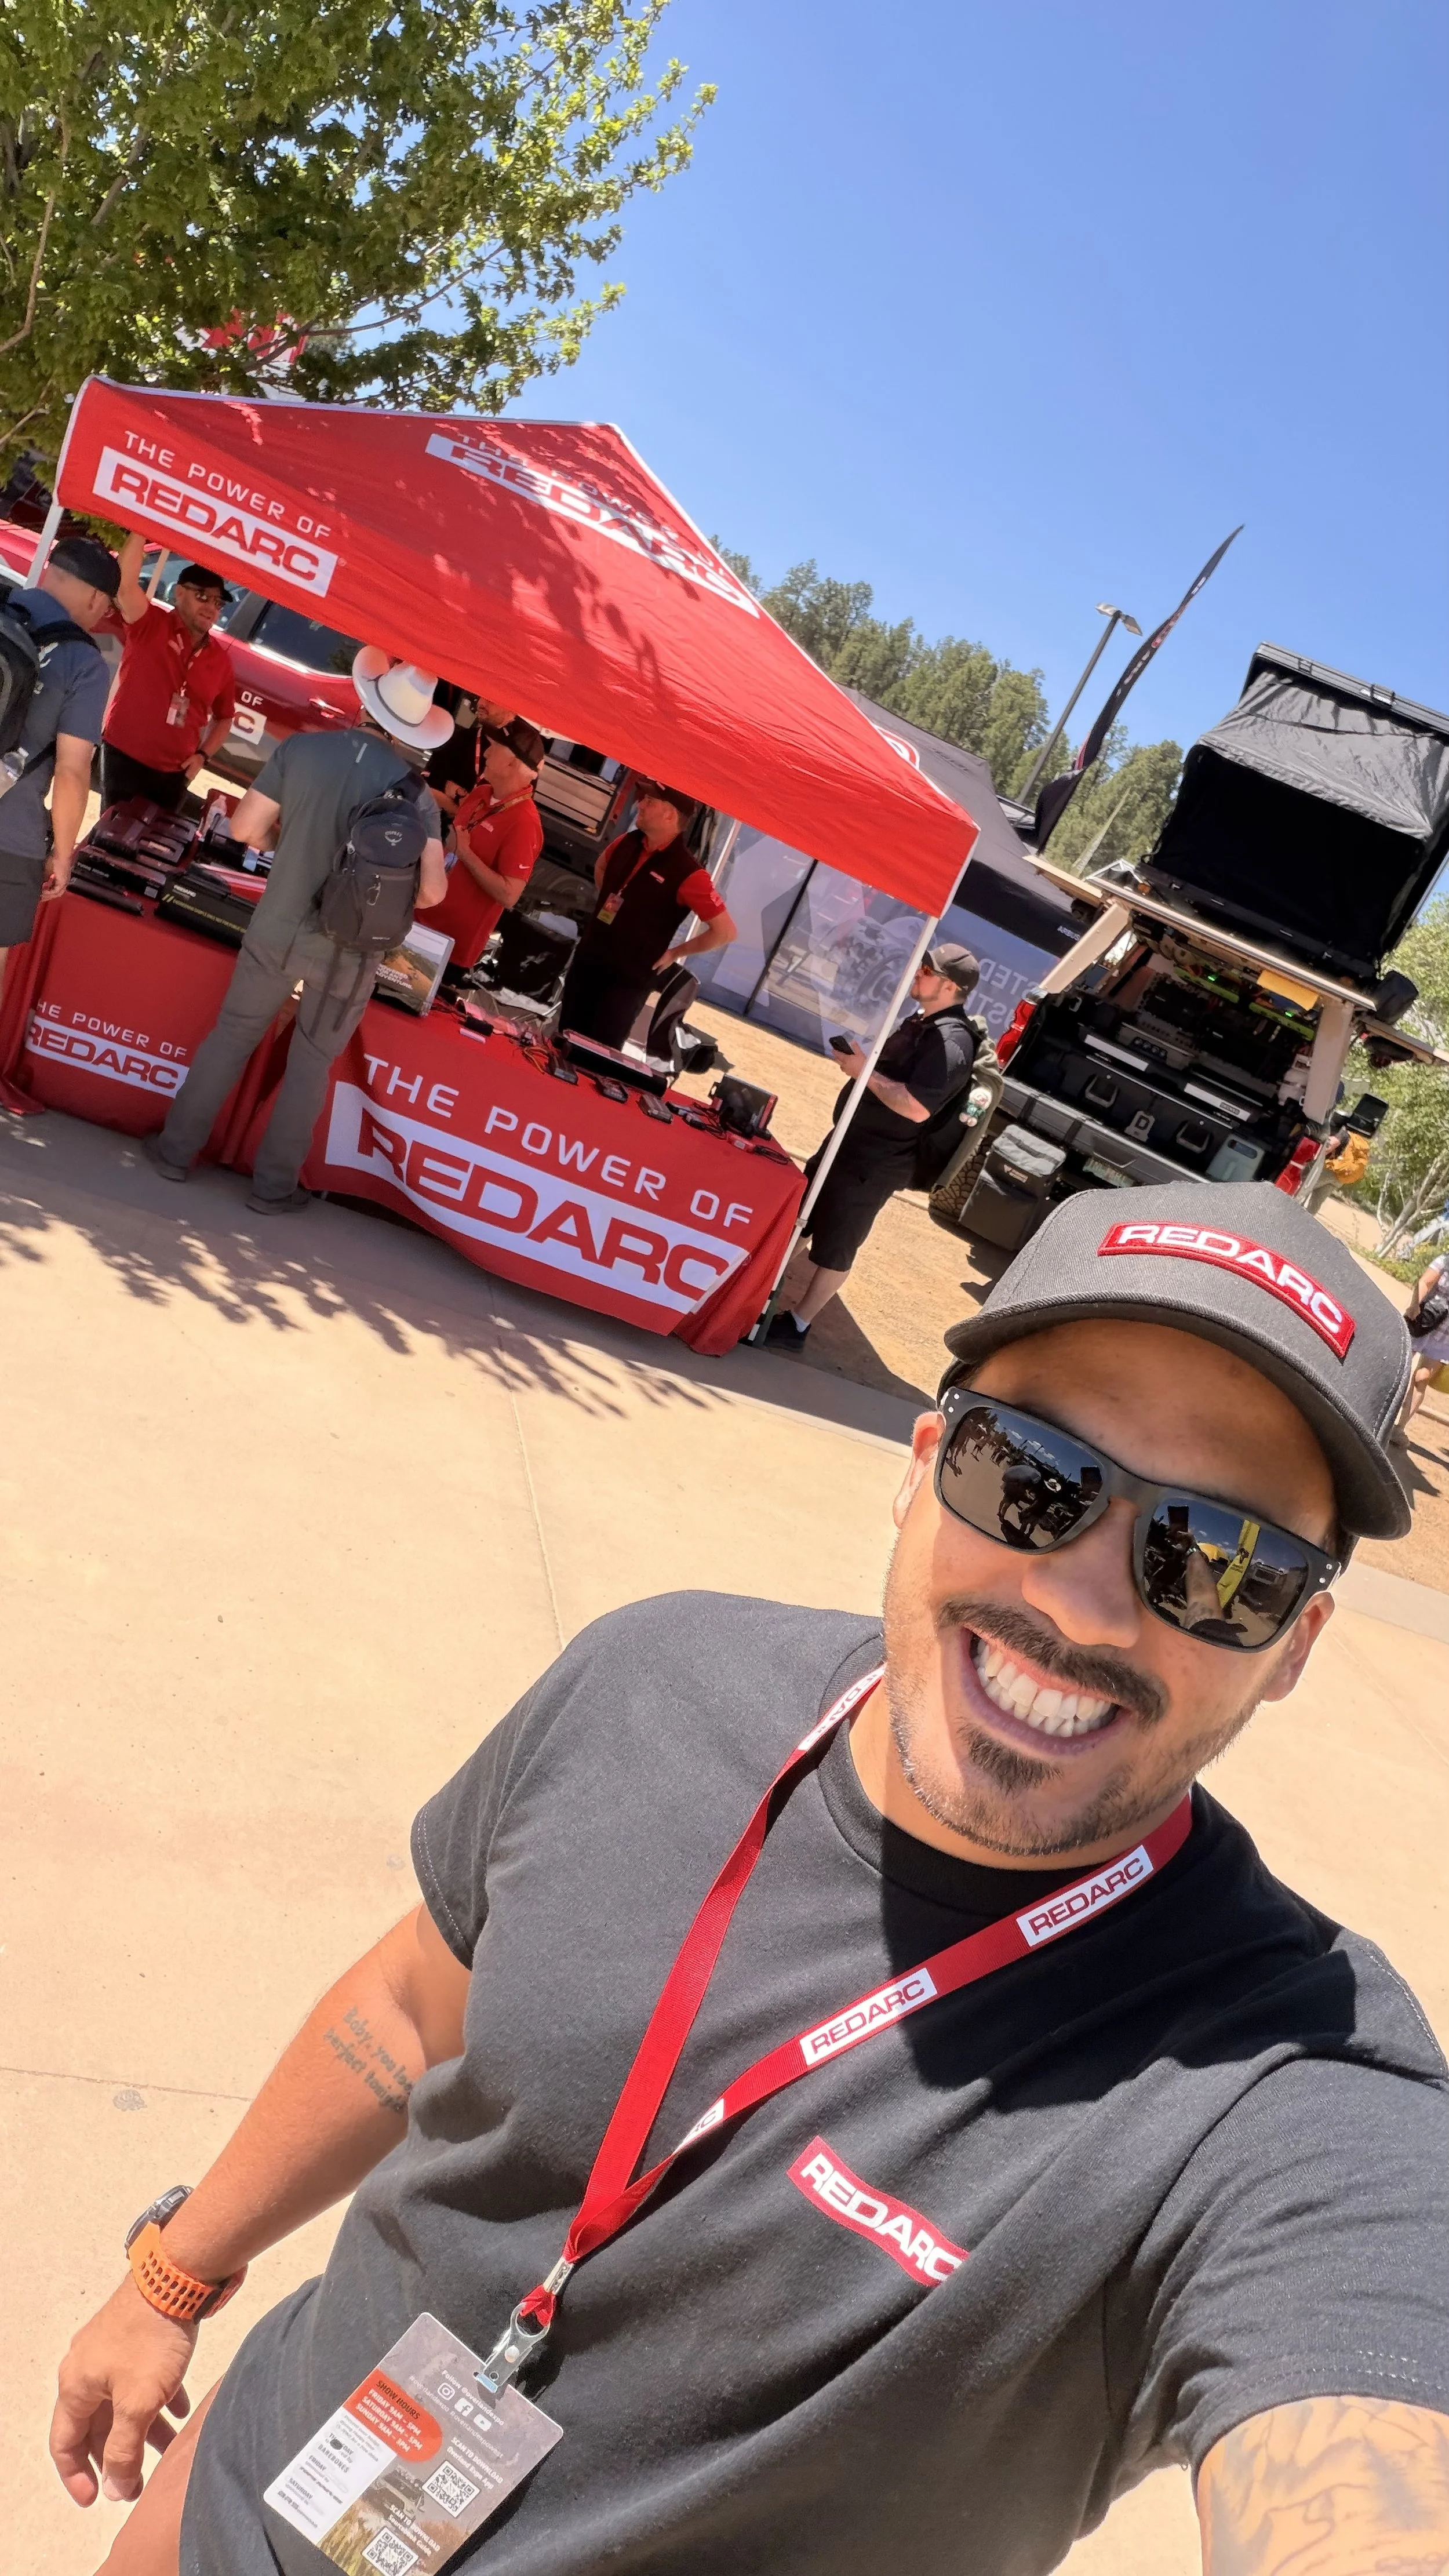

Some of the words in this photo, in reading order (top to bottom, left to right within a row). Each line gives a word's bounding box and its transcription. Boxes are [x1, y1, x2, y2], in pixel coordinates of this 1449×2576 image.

[125, 431, 176, 468] THE
[188, 463, 285, 520] POWER
[296, 515, 331, 539] OF
[111, 463, 319, 580] REDARC
[451, 445, 740, 601] REDARC
[241, 690, 264, 706] OF
[27, 1022, 179, 1090] REDARC
[37, 999, 61, 1018] HE
[72, 1012, 150, 1048] POWER
[159, 1041, 187, 1058] OF
[363, 1053, 459, 1119] THE
[484, 1105, 667, 1201] POWER
[690, 1190, 753, 1228] OF
[357, 1105, 730, 1298] REDARC
[1117, 1225, 1342, 1333] REDARC
[1028, 1857, 1144, 1935] REDARC
[810, 1979, 924, 2054] REDARC
[800, 2153, 962, 2280] REDARC
[361, 2395, 392, 2423] SATURDAY
[367, 2388, 391, 2409] FRIDAY
[387, 2405, 404, 2421] 9AM
[375, 2379, 397, 2400] SHOW
[395, 2397, 421, 2420] HOURS
[440, 2369, 463, 2389] Follow
[328, 2432, 354, 2455] THDAY
[354, 2402, 380, 2426] SUNDAY
[450, 2436, 467, 2452] SCAN
[464, 2448, 475, 2458] TO
[472, 2455, 504, 2484] DOWNLOAD
[388, 2504, 405, 2520] SCAN
[402, 2516, 412, 2526] TO
[409, 2523, 442, 2552] DOWNLOAD
